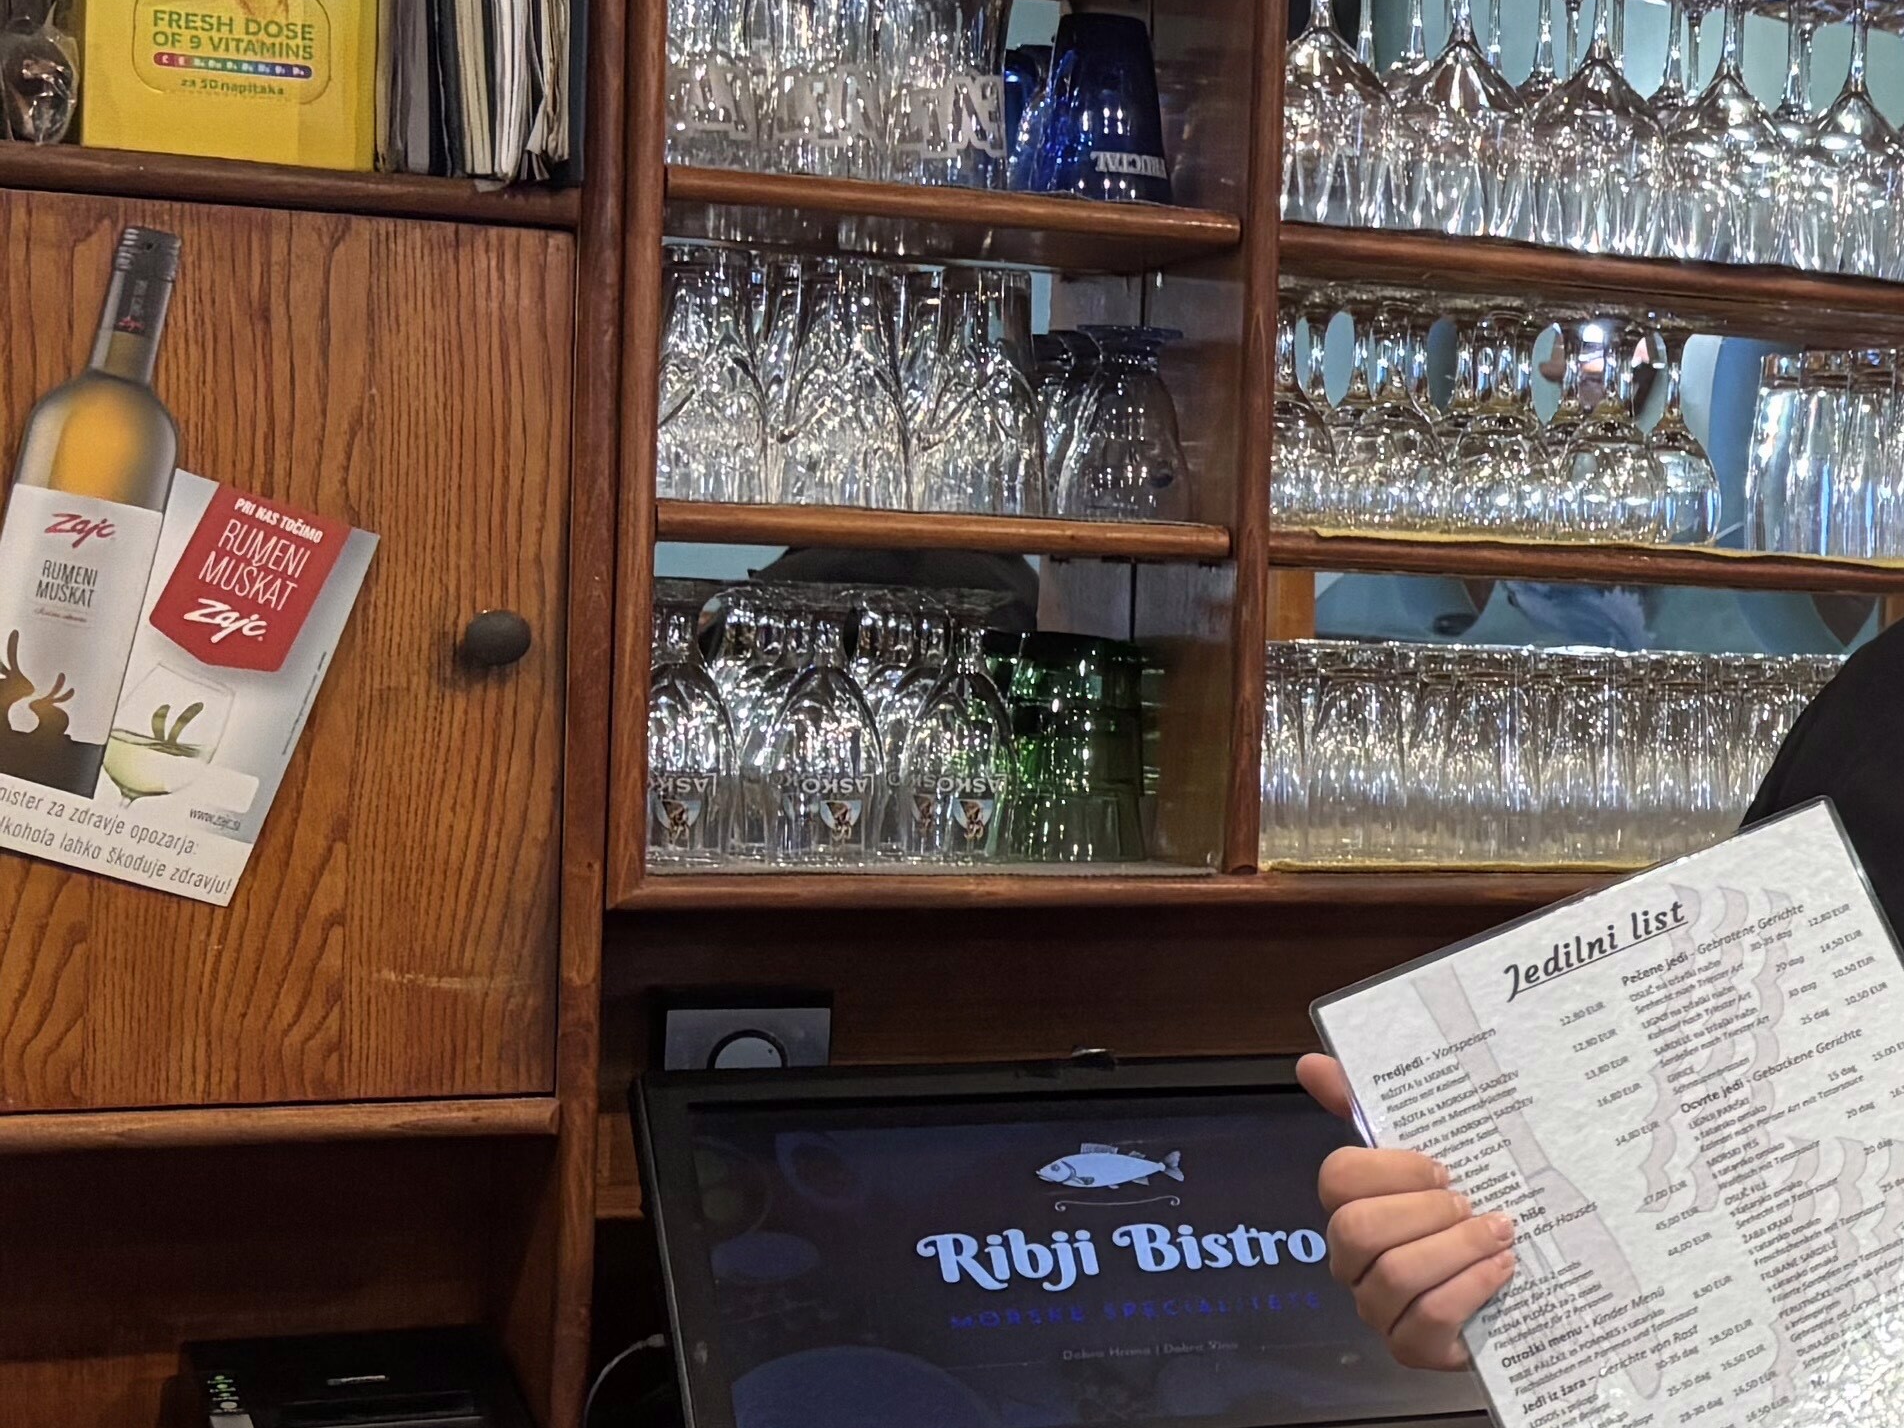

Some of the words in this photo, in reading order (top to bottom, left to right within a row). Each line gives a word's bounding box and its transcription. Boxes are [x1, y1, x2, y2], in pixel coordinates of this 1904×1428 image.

[152, 8, 235, 36] FRESH
[244, 17, 315, 42] DOSE
[152, 30, 182, 50] OF
[189, 35, 202, 50] 9
[208, 36, 315, 61] VITAMINS
[220, 80, 285, 97] napitaka
[45, 512, 116, 549] Zajc
[234, 497, 256, 518] PRI
[280, 513, 324, 544] TOČIMO
[217, 518, 311, 579] RUMENI
[42, 559, 99, 587] RUMENI
[183, 597, 267, 644] Zajc
[46, 799, 65, 818] za
[69, 802, 125, 835] zdravje
[130, 822, 199, 856] opozarja:
[59, 831, 102, 861] lahko
[106, 843, 168, 878] škoduje
[169, 865, 233, 896] zdravju!
[1503, 924, 1620, 1003] Jedilni
[1631, 897, 1687, 942] list
[1619, 960, 1665, 987] Pečene
[1663, 950, 1690, 970] jedi
[1755, 902, 1805, 930] Gerichte
[1371, 1055, 1425, 1087] Predjedi
[1431, 1025, 1498, 1062] Vorspeisen
[1678, 1088, 1721, 1114] Ocvrte
[1719, 1077, 1746, 1098] jedi
[1813, 1026, 1863, 1055] Gerichte
[1839, 1062, 1858, 1077] dag
[1518, 1202, 1547, 1223] hiše
[1531, 1219, 1554, 1237] des
[916, 1228, 1101, 1292] Ribji
[1111, 1223, 1328, 1272] Bistro
[950, 1305, 1085, 1331] MORSKE
[1499, 1338, 1547, 1369] Otroški
[1546, 1324, 1584, 1348] menu
[1589, 1301, 1631, 1328] Kinder
[1520, 1393, 1549, 1415] Jedi
[1559, 1376, 1587, 1396] žara
[1647, 1337, 1672, 1356] von
